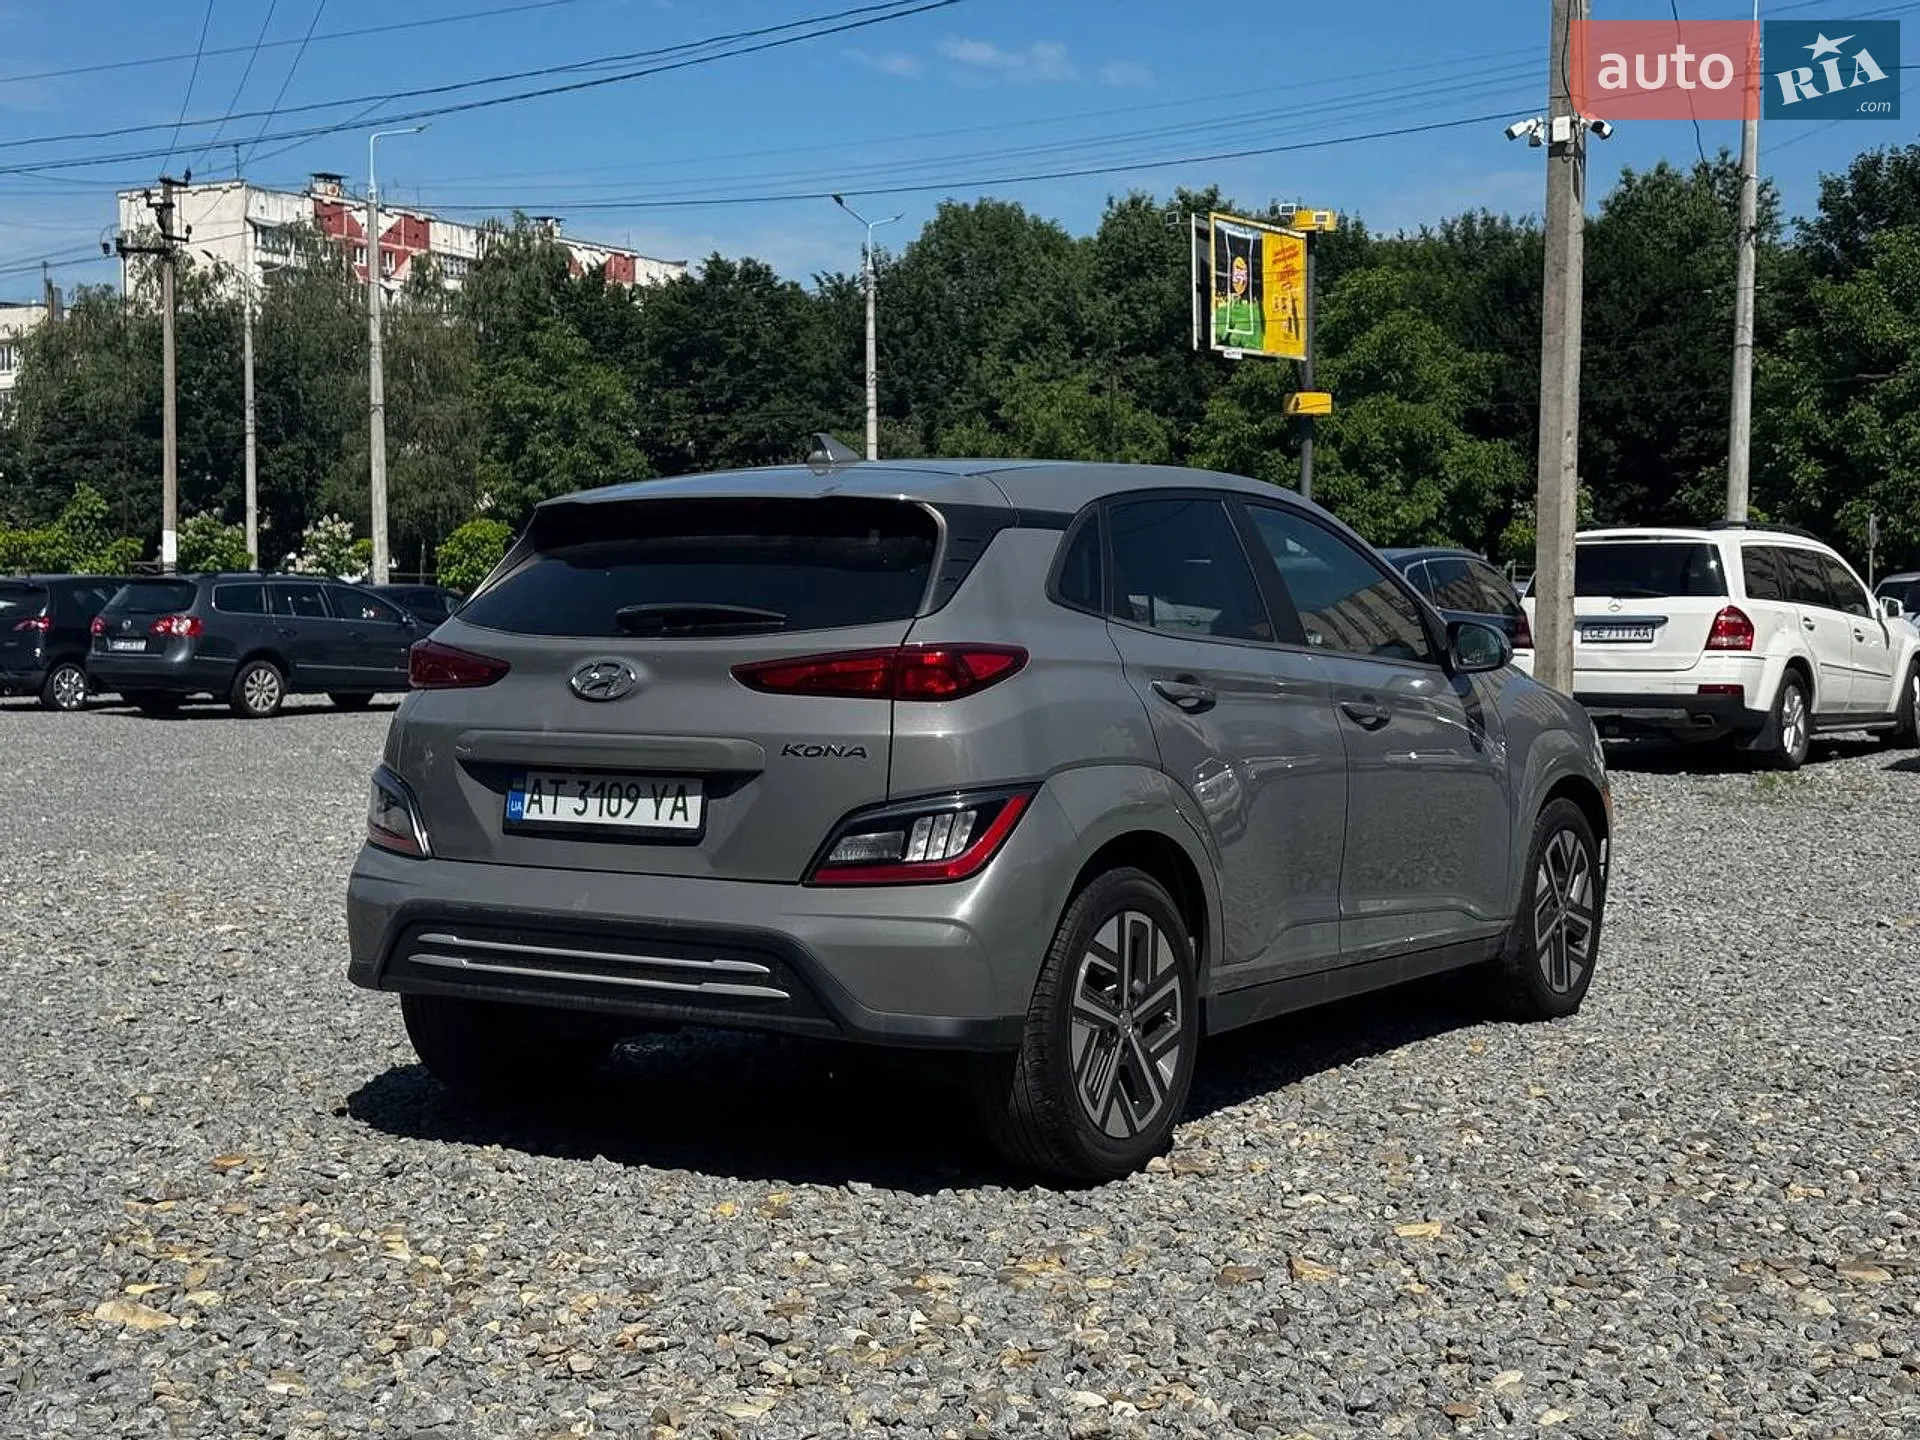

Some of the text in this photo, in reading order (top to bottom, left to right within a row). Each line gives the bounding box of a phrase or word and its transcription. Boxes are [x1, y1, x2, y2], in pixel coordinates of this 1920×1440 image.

[781, 744, 867, 758] KONA
[526, 778, 690, 822] AT 3109 YA
